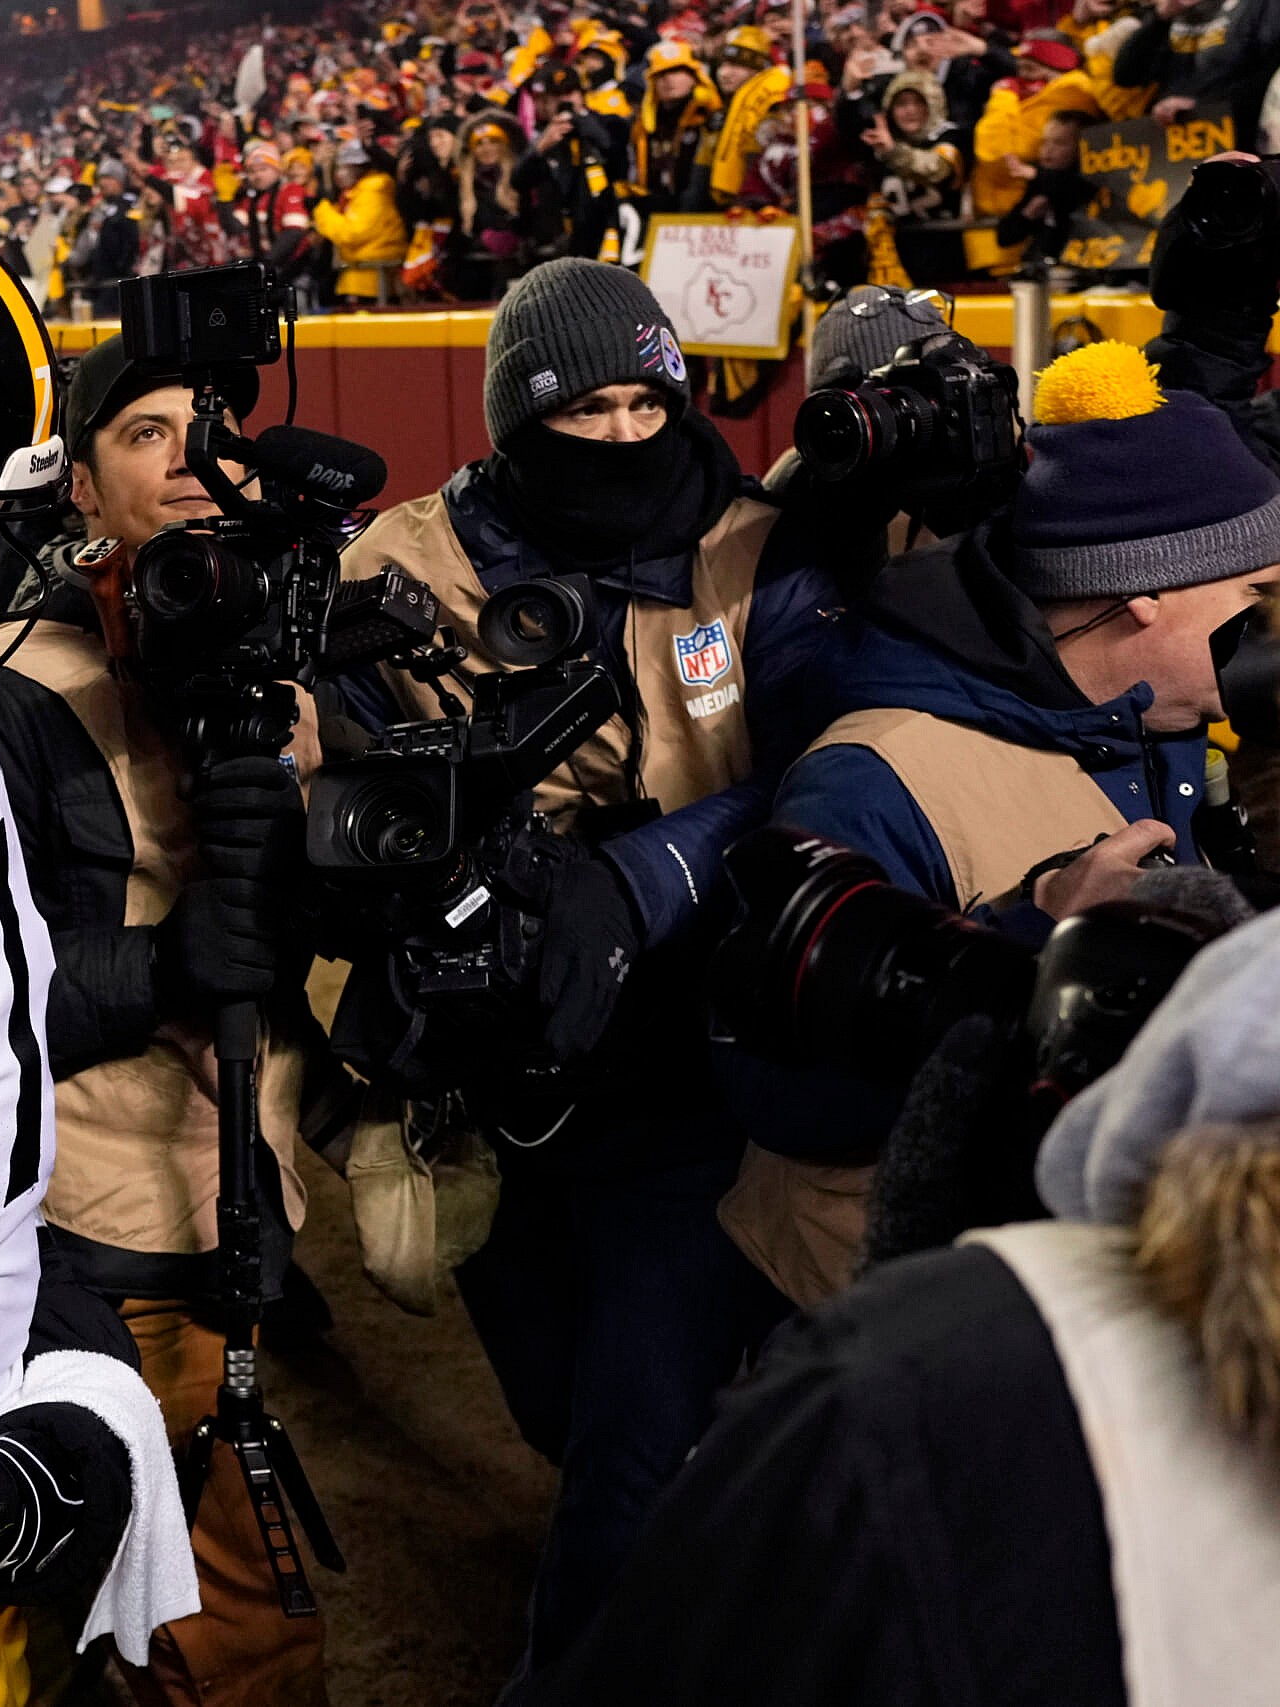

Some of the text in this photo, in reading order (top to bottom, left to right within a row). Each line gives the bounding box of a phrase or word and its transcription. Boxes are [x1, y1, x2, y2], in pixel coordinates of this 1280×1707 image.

[1079, 115, 1234, 184] baby BEN
[31, 364, 52, 446] 7
[684, 646, 726, 678] NFL
[686, 683, 740, 720] MEDIA
[666, 842, 699, 905] OMNI-HEAT
